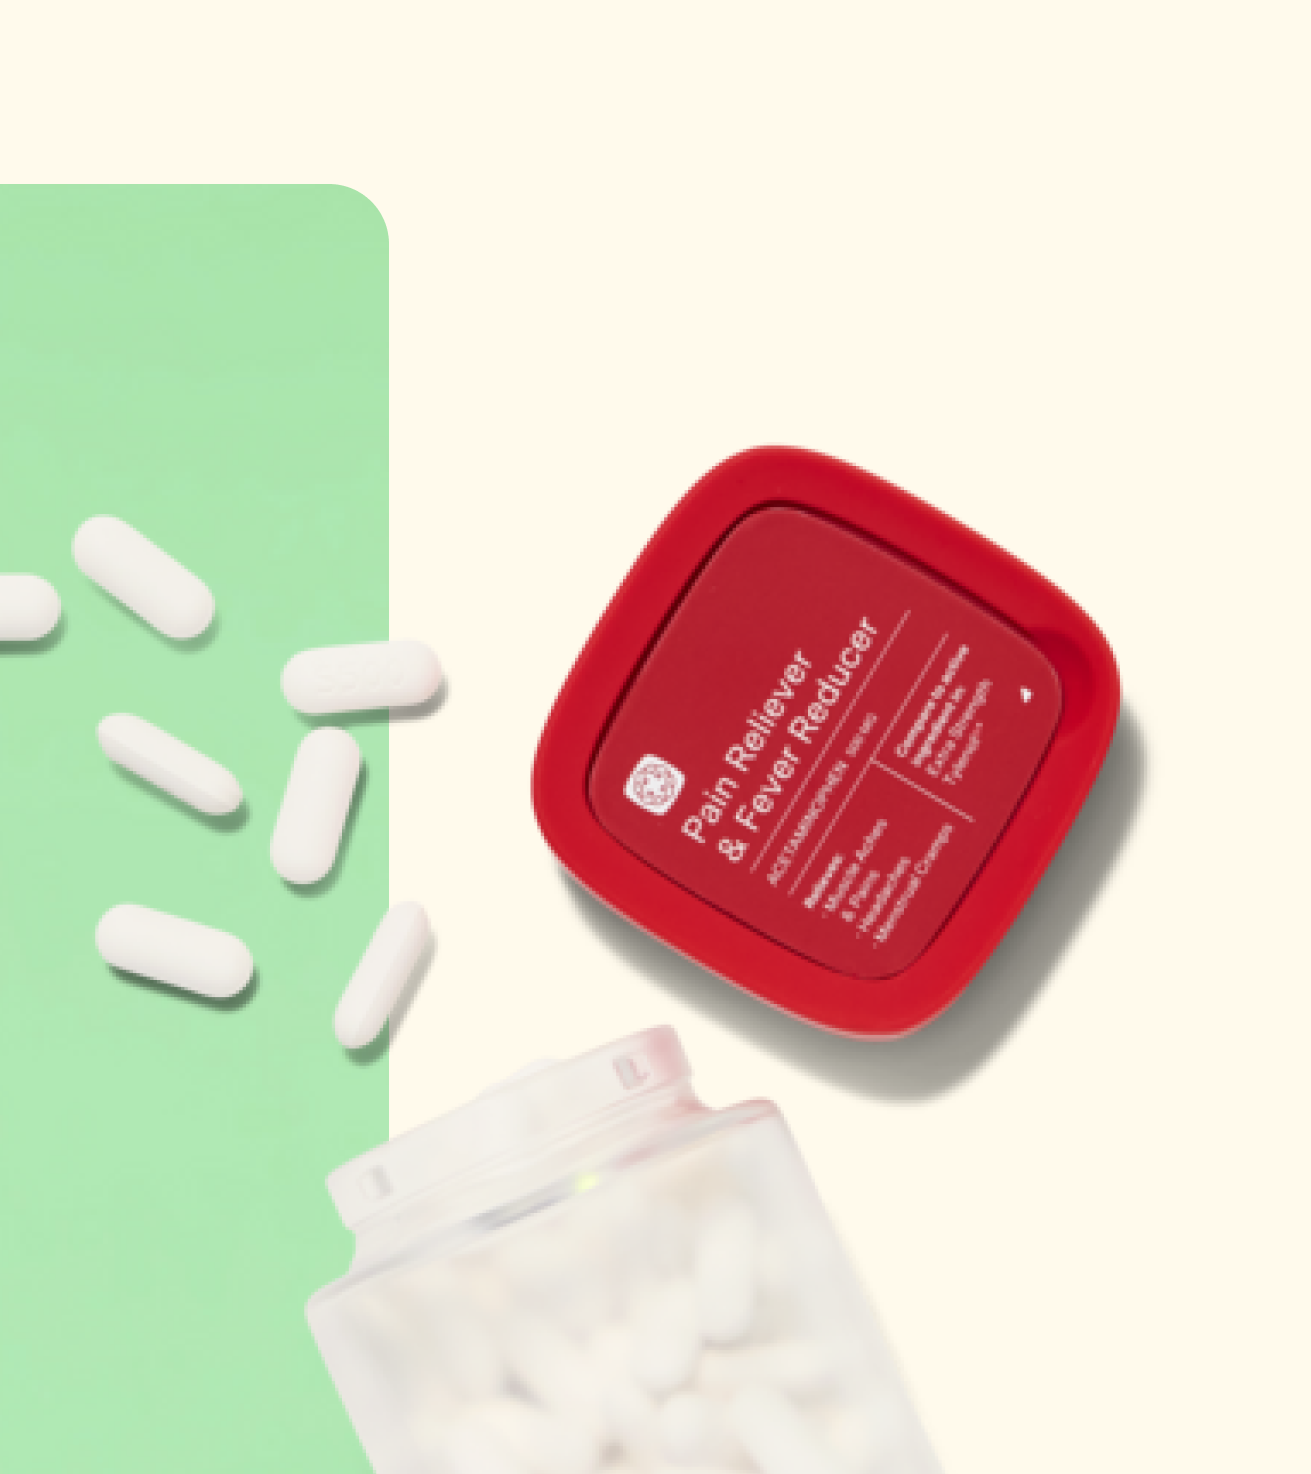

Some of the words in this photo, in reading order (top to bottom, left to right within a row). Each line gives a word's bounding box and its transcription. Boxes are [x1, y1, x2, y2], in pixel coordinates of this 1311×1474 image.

[680, 777, 737, 844] Pain
[724, 650, 812, 772] Reliever
[718, 838, 748, 862] &
[735, 746, 799, 833] Fever
[787, 616, 878, 744] Reducer
[766, 760, 850, 885] ACETAMINOPHEN
